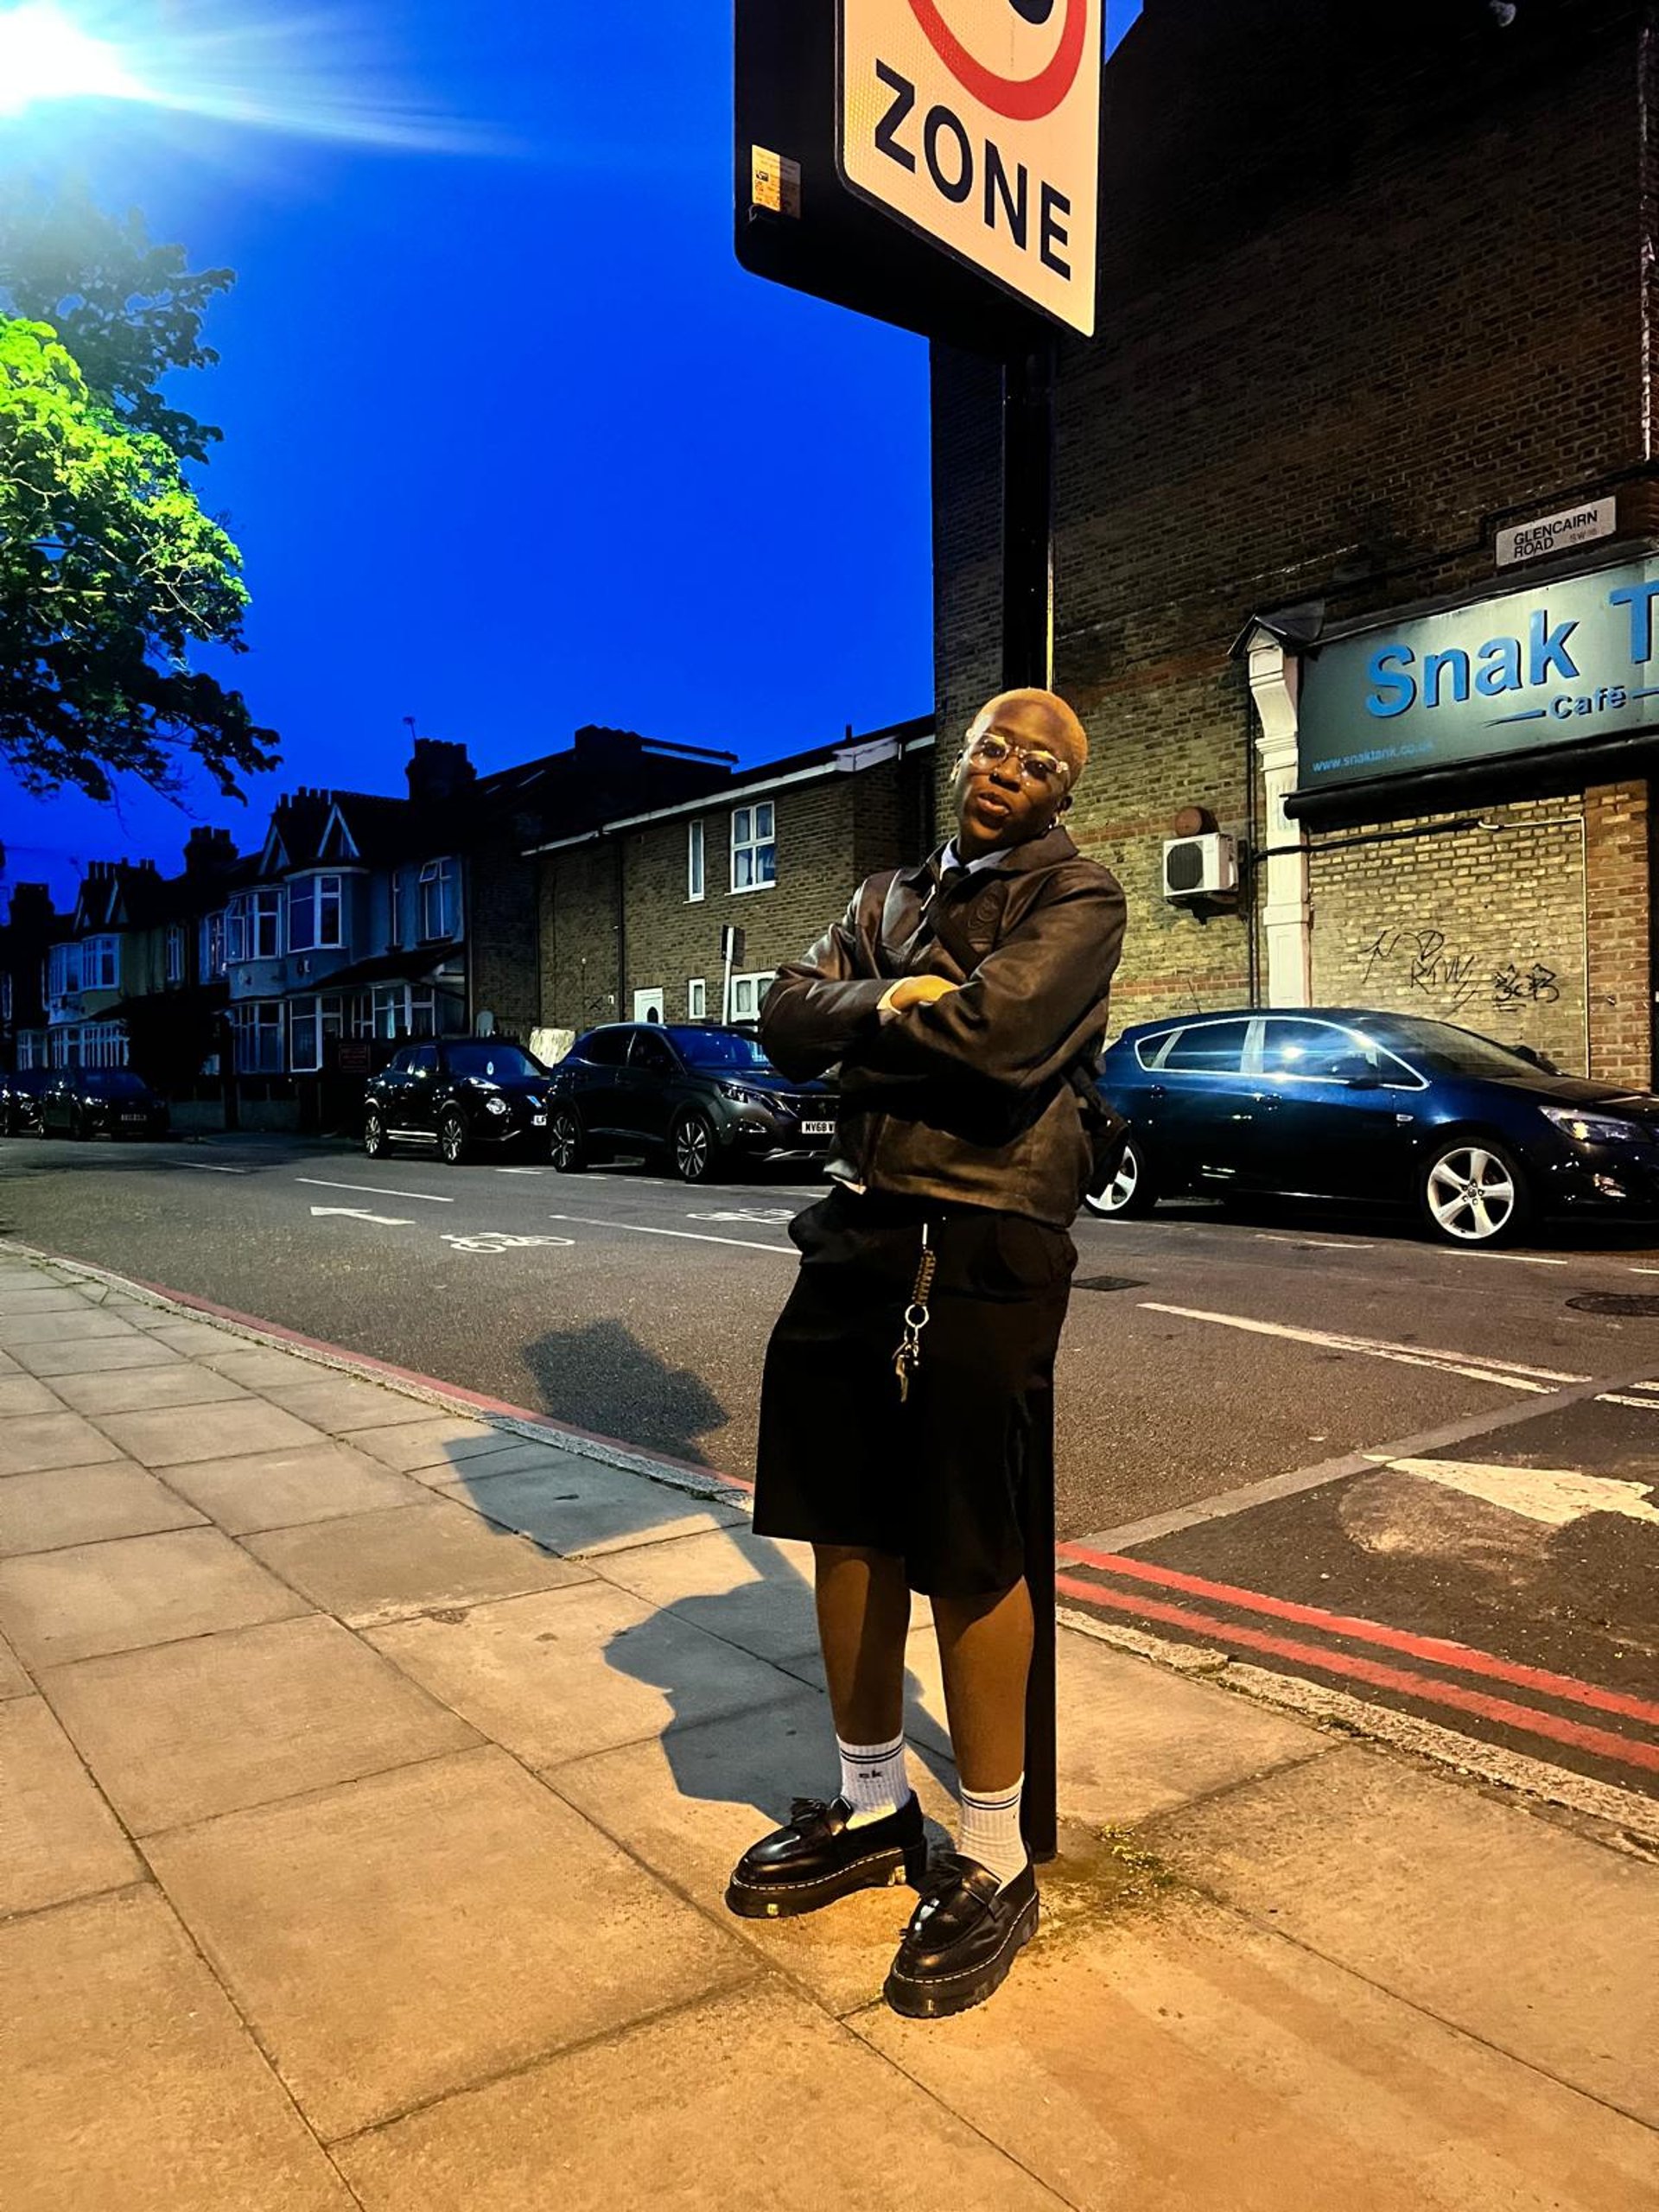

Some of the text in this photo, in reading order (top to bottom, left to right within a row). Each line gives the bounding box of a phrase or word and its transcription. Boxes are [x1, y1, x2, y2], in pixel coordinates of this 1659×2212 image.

[875, 58, 1071, 281] ZONE
[1514, 510, 1598, 545] GLENCAIRN
[1514, 537, 1554, 558] ROAD
[1365, 609, 1580, 718] Snak
